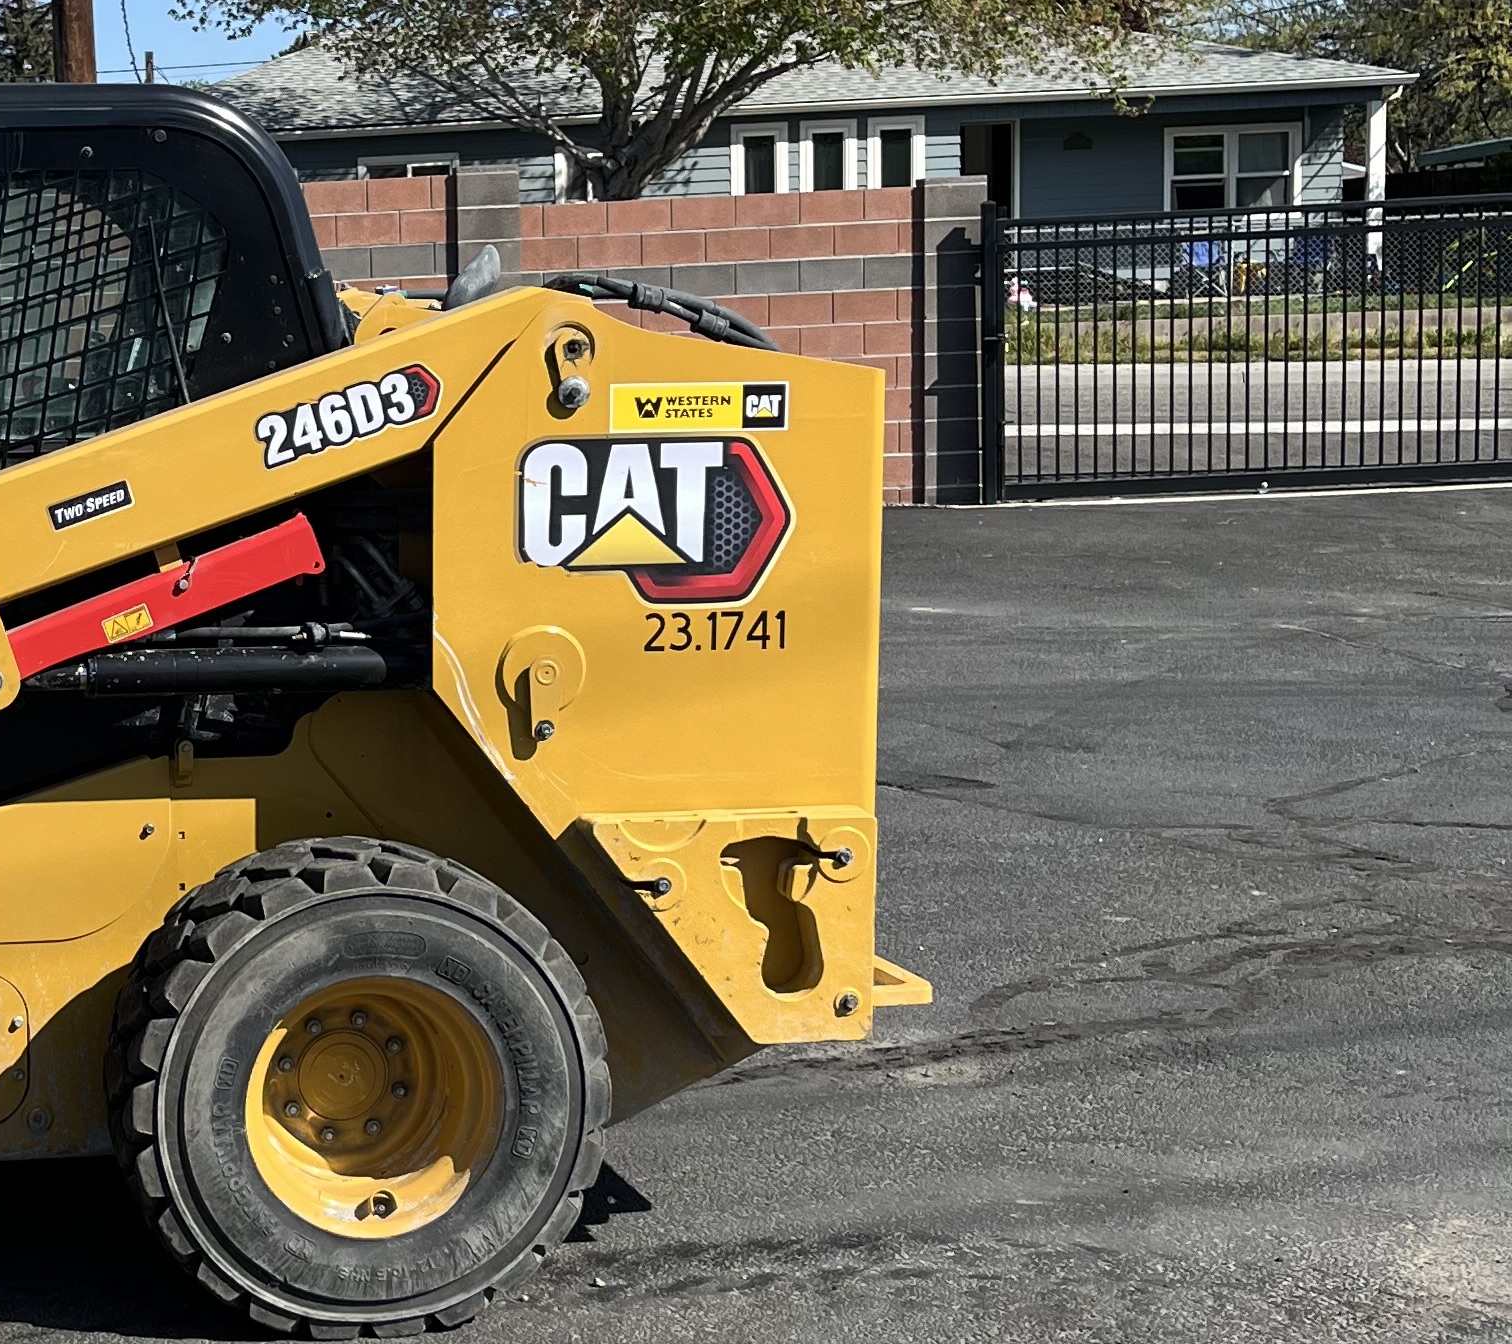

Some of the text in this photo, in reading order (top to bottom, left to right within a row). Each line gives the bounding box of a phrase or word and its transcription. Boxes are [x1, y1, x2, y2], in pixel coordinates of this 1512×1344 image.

[664, 408, 714, 419] STATES
[665, 395, 731, 406] WESTERN
[745, 394, 782, 418] CAT
[257, 373, 415, 465] 246D3
[522, 441, 724, 566] CAT
[643, 610, 787, 652] 23.1741
